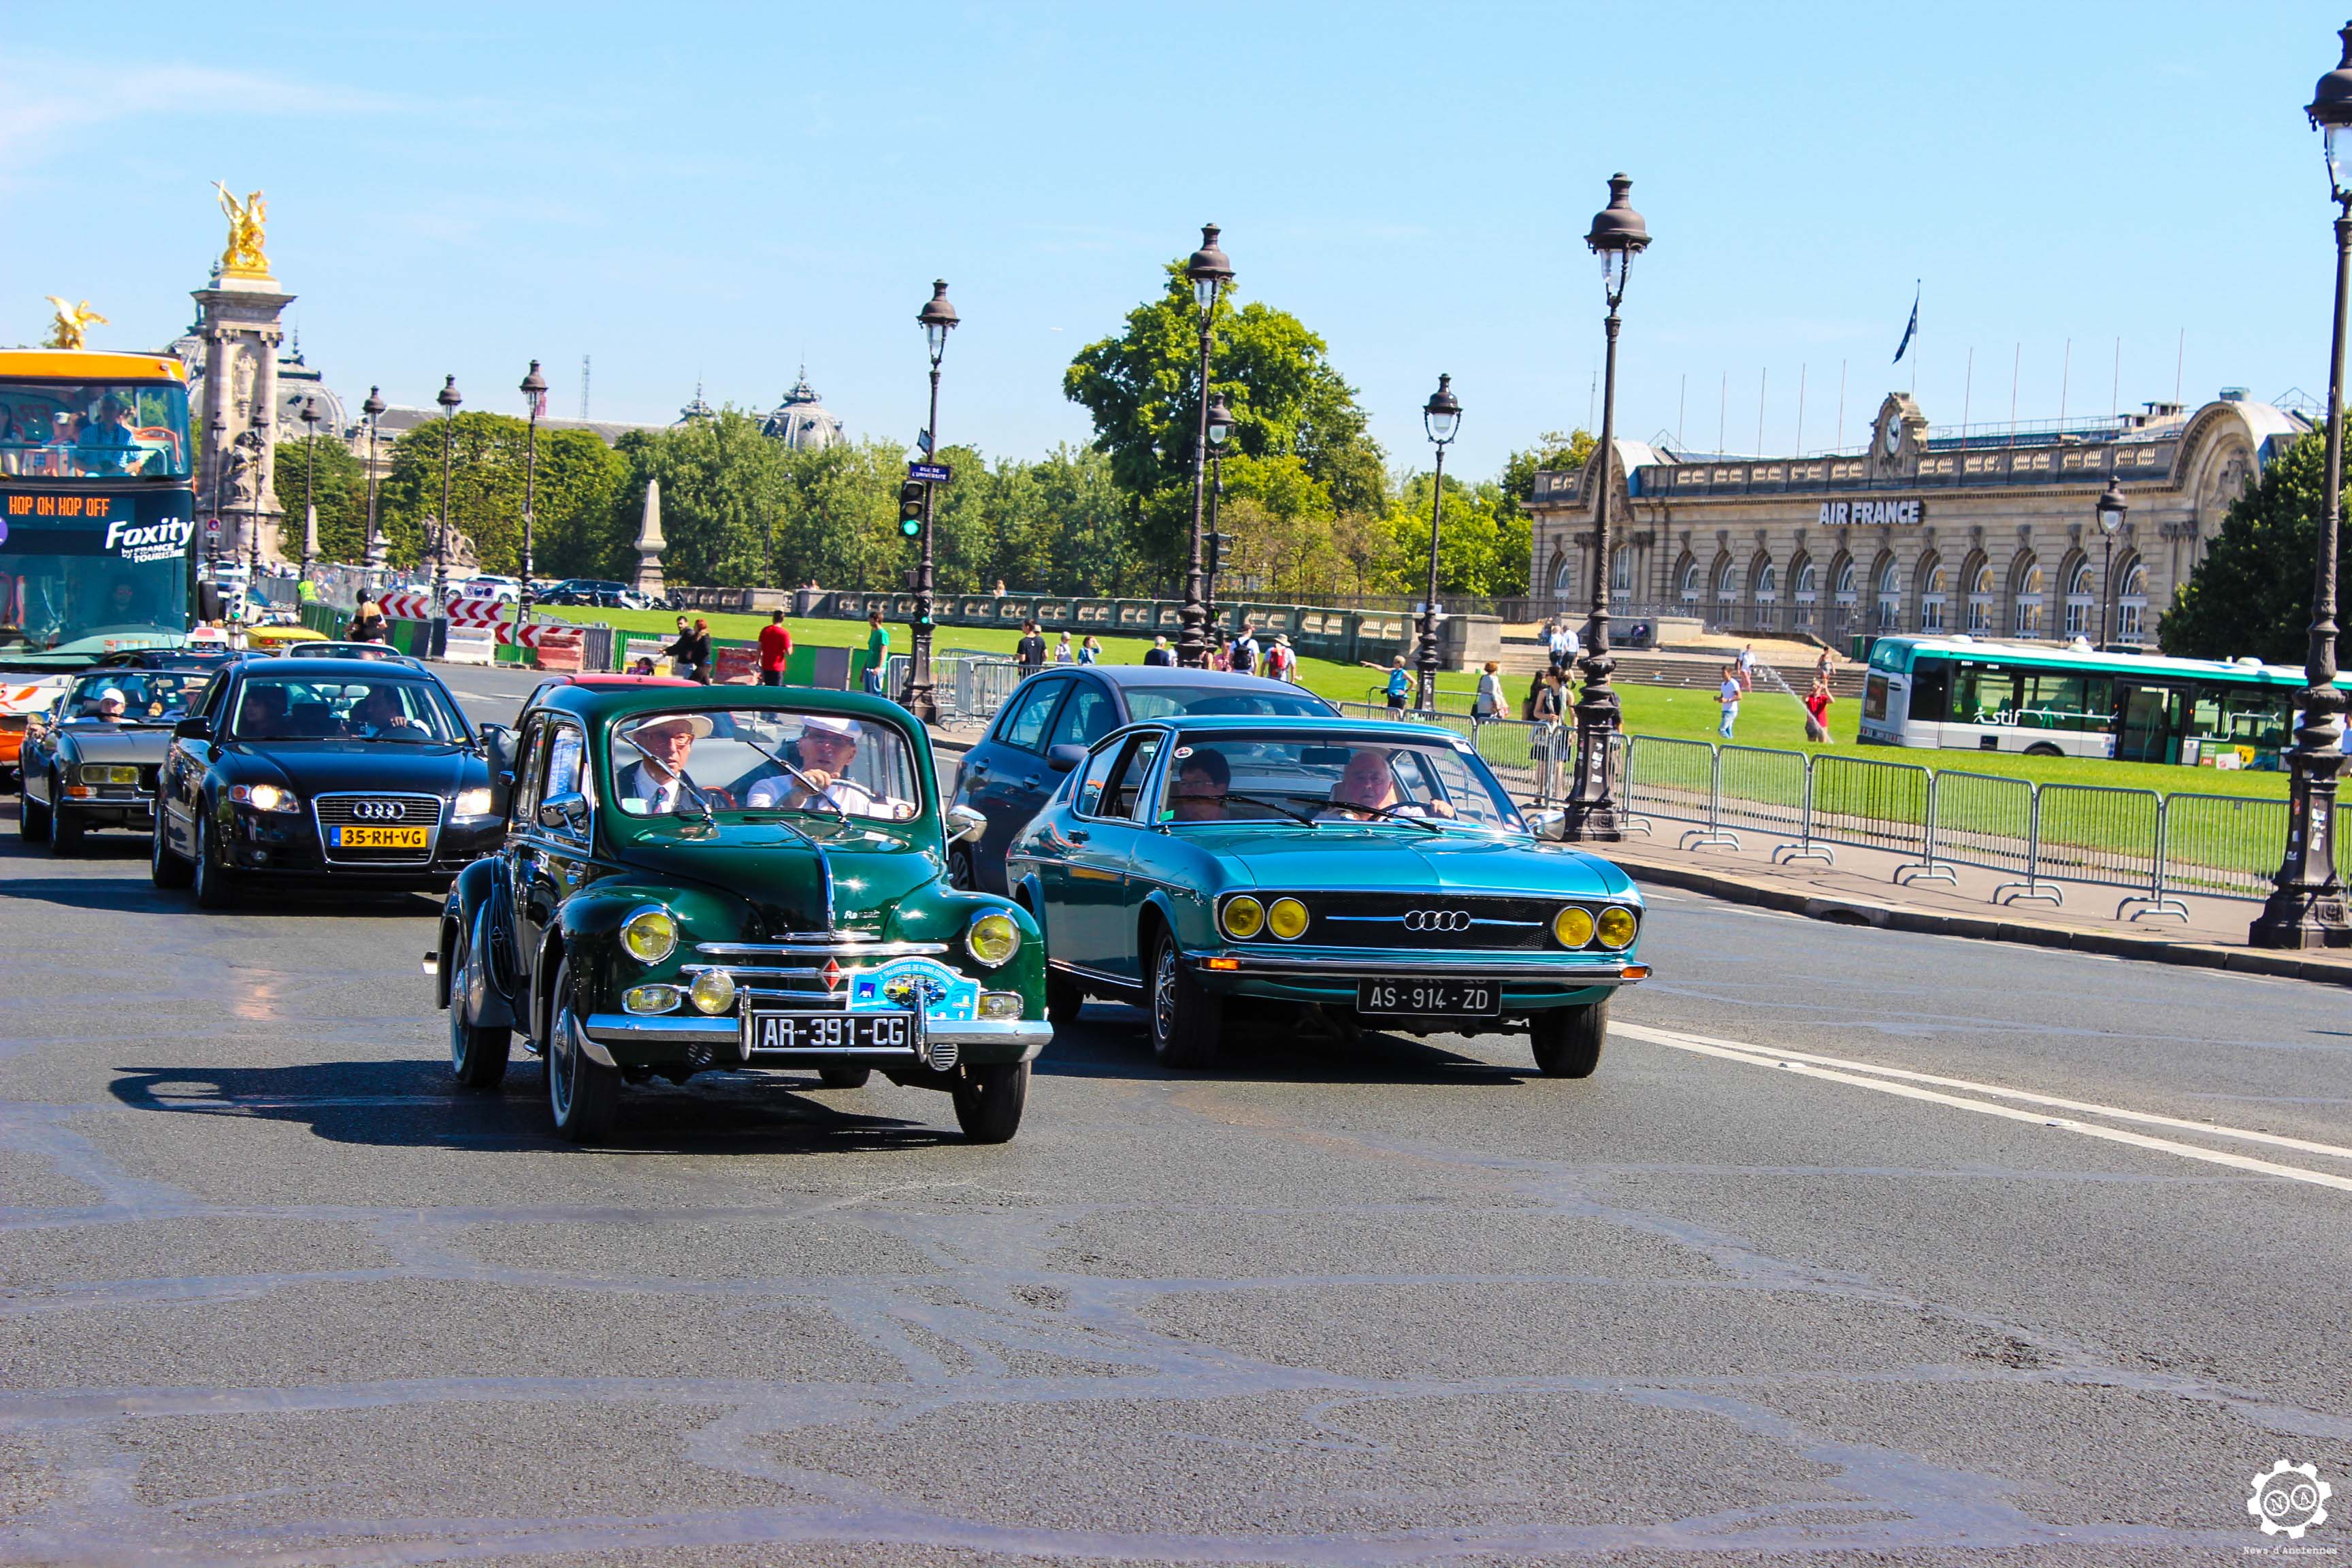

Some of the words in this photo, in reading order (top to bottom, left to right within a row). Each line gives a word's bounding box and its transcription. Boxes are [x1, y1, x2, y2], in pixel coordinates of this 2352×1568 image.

[9, 495, 33, 515] HOP
[37, 497, 54, 516] ON
[58, 497, 82, 517] HOP
[86, 497, 110, 517] OFF
[1818, 502, 1848, 525] AIR
[1851, 501, 1919, 525] FRANCE
[105, 517, 195, 549] Foxity
[121, 548, 133, 559] by
[134, 542, 175, 556] FRANCE
[133, 548, 185, 564] TOURISME
[1992, 708, 2021, 726] stif
[344, 829, 421, 845] 35-RH-VG
[1370, 987, 1488, 1010] AS-914-ZD
[763, 1018, 904, 1047] AR-391-CG
